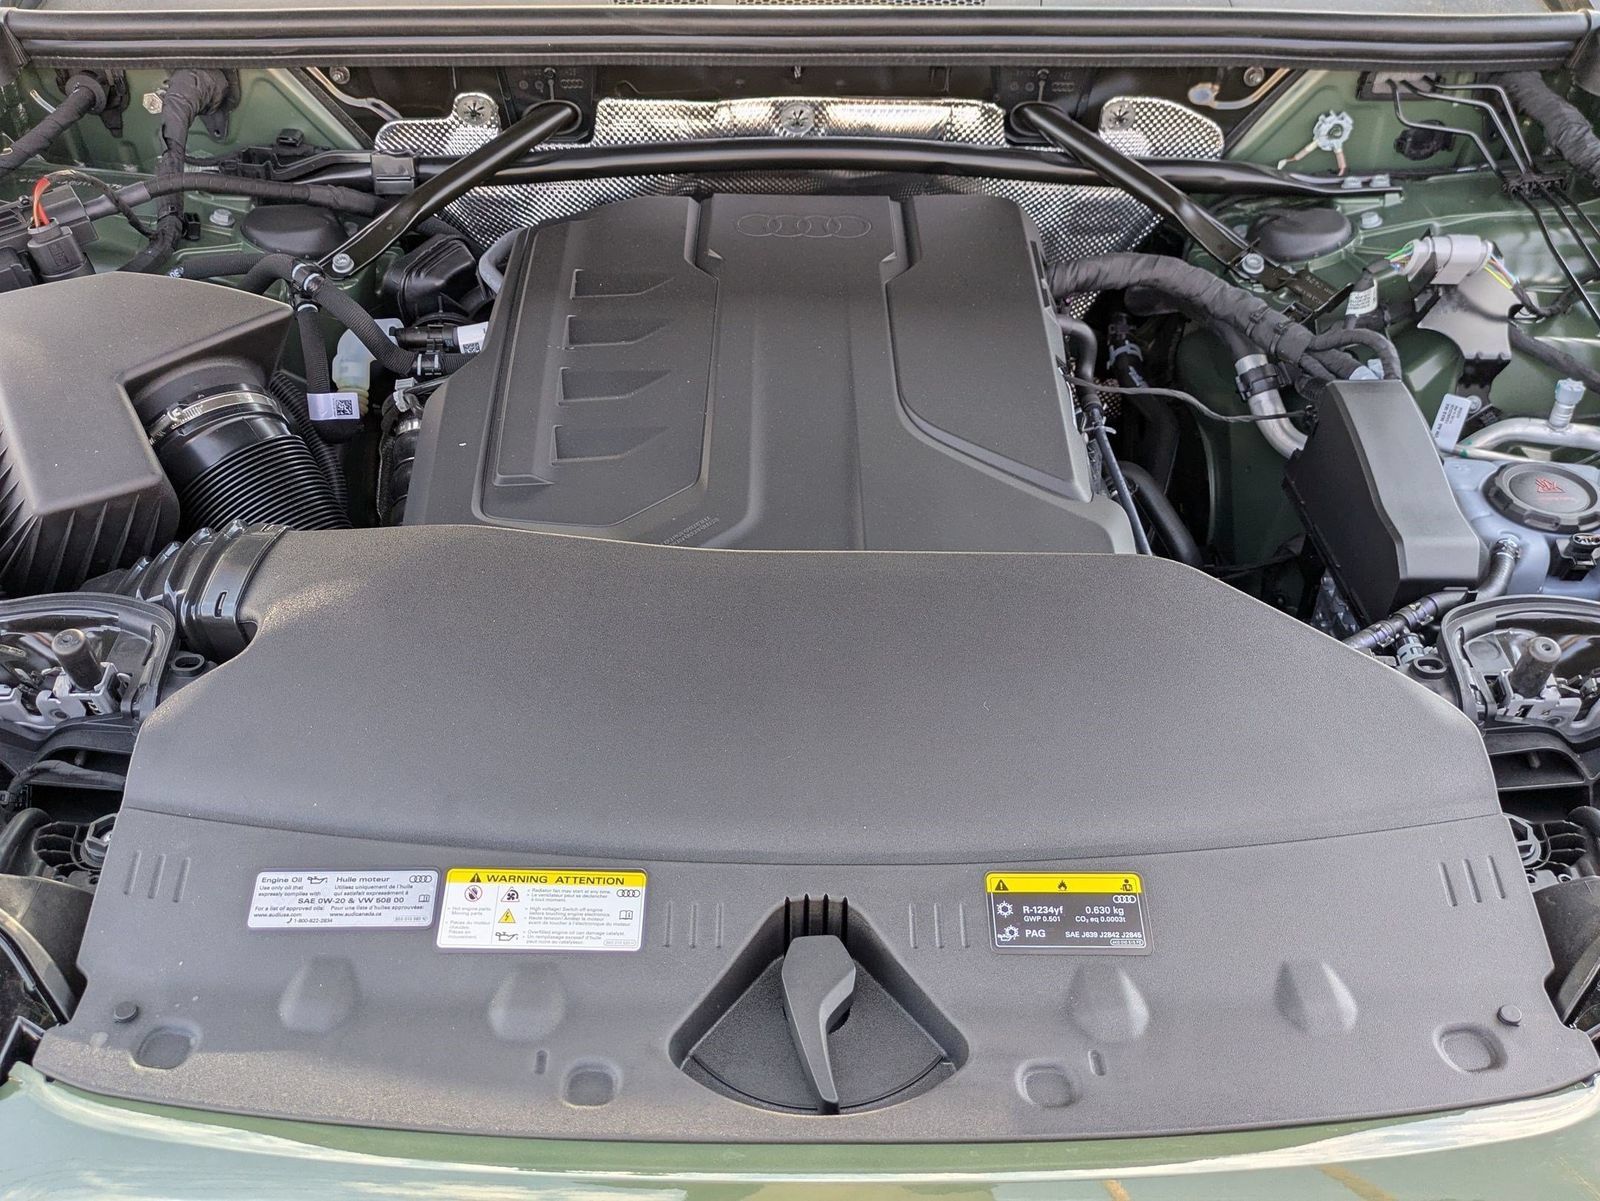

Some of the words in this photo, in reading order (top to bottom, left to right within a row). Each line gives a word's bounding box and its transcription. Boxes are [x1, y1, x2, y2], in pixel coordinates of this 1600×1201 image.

[486, 875, 548, 883] WARNING
[555, 876, 625, 885] ATTENTION
[1023, 906, 1064, 915] R-1234yf
[1113, 906, 1124, 916] kg
